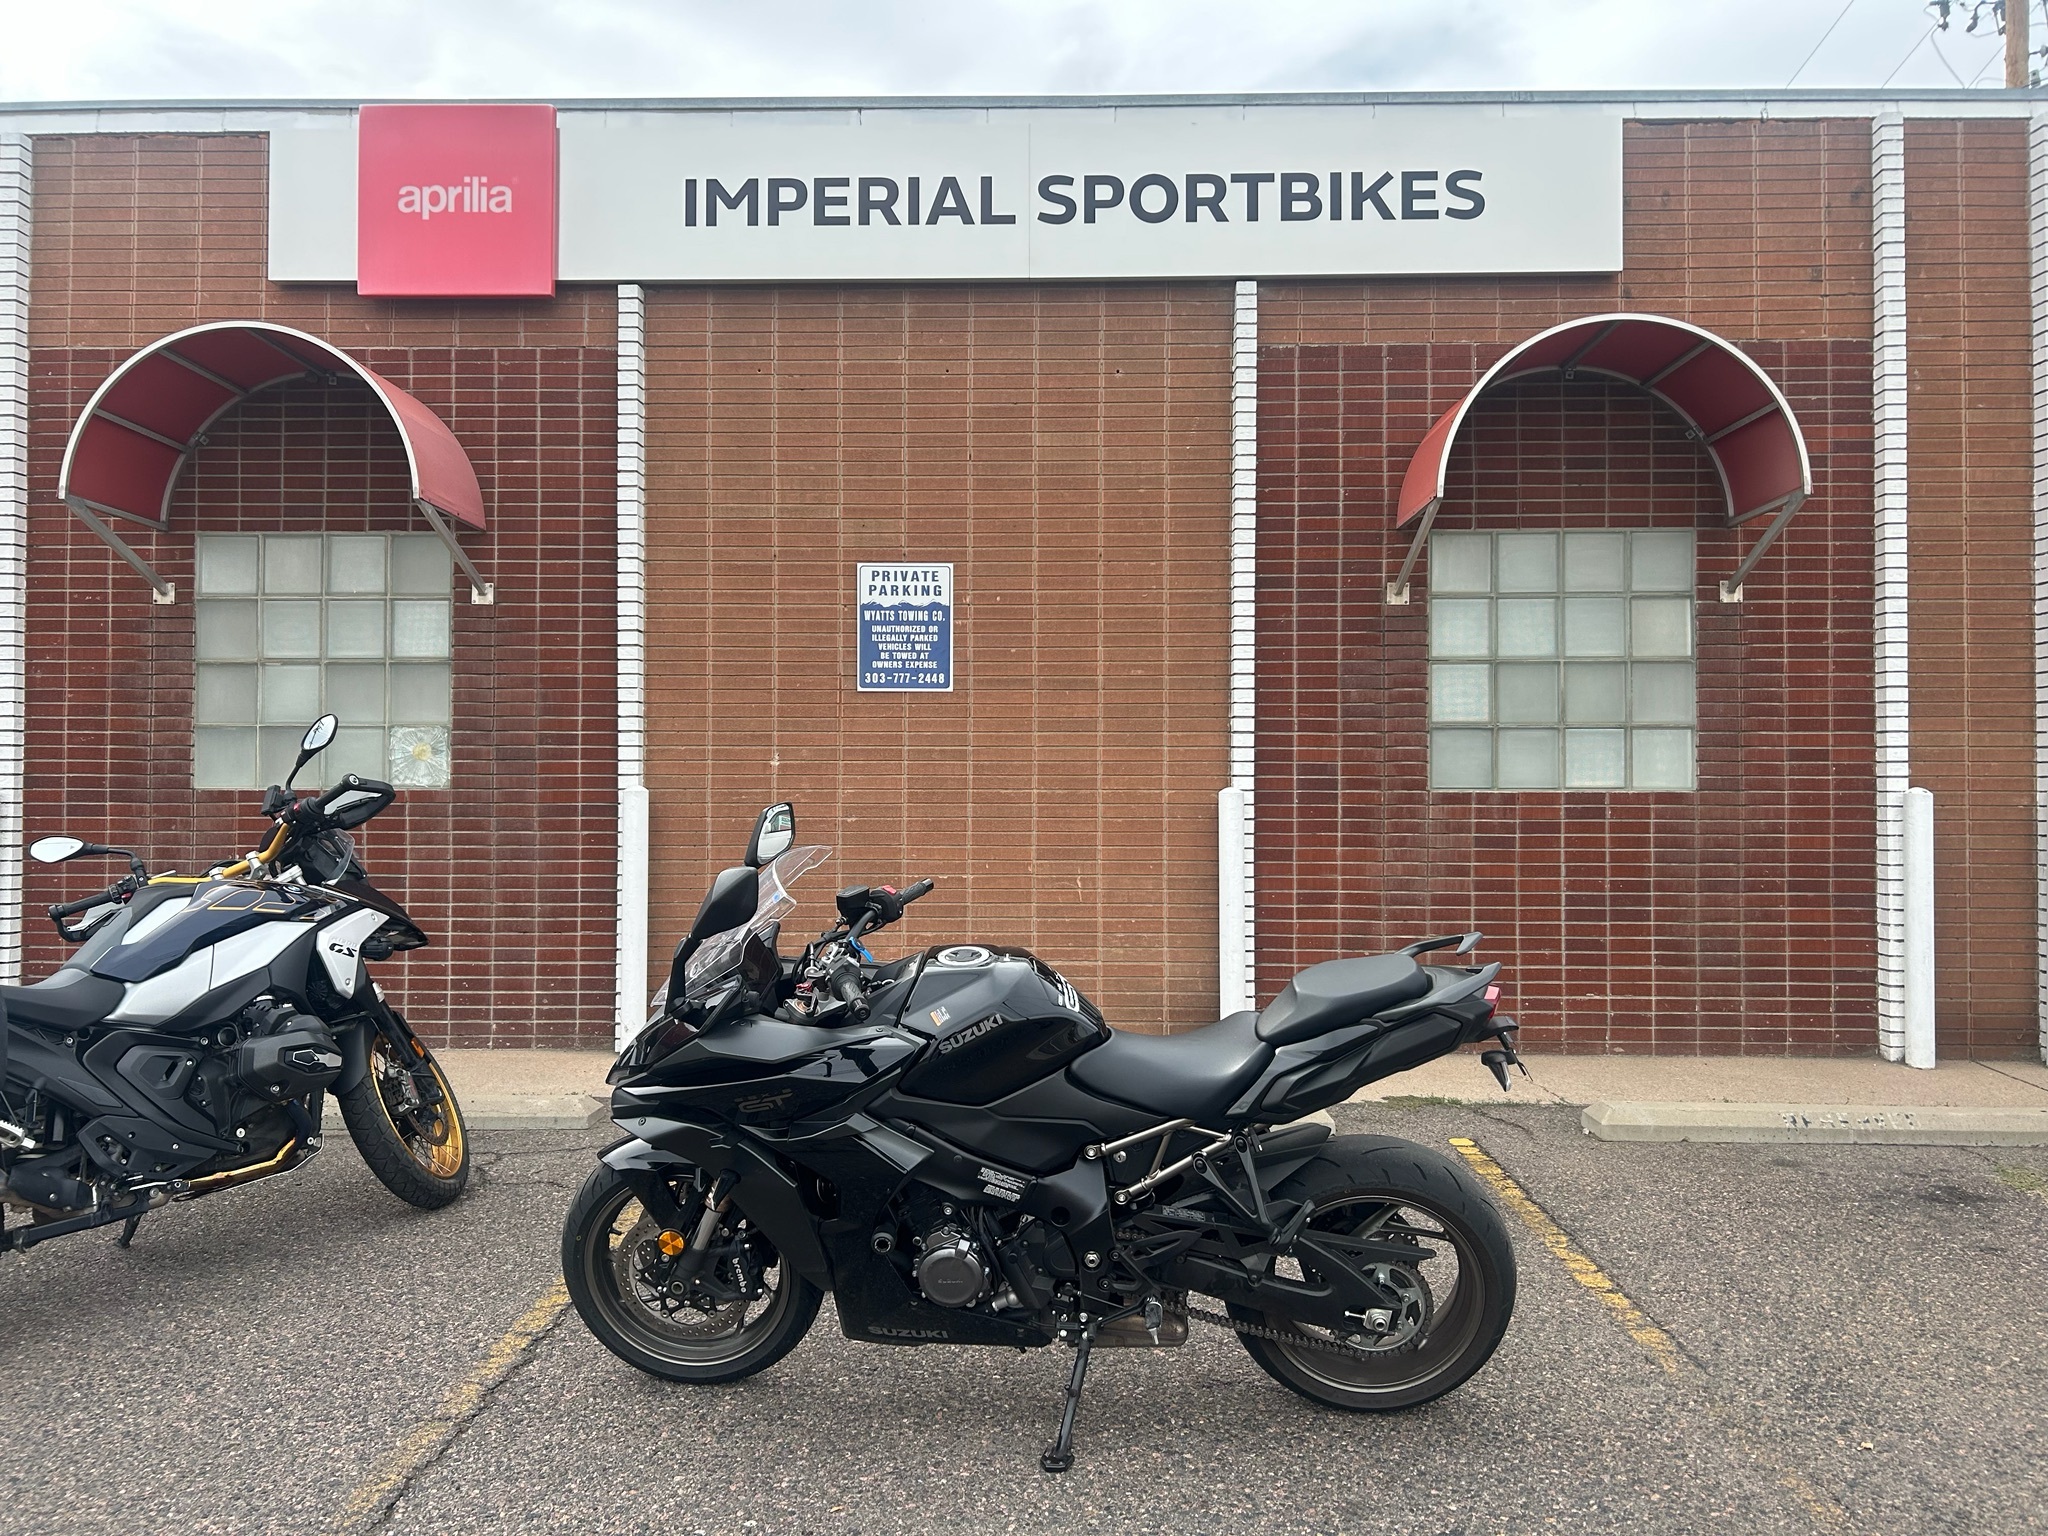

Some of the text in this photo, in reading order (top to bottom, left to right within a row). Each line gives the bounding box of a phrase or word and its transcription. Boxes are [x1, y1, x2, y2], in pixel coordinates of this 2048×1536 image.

[397, 176, 512, 220] aprilia
[684, 170, 1487, 227] IMPERIAL SPORTBIKES
[871, 570, 940, 582] PRIVATE
[868, 585, 942, 596] PARKING
[864, 610, 945, 621] WYATTS TOWING CO.
[871, 625, 939, 633] UNAUTHORIZED OR
[871, 634, 939, 642] ILLEGALLY PARKED
[877, 643, 932, 651] VEHICLES WILL
[880, 652, 930, 660] BE TOWED AT
[871, 661, 938, 669] OWNERS EXPENSE
[864, 672, 945, 684] 303-777-2448
[938, 1013, 1004, 1055] SUZUKI
[732, 1257, 747, 1293] brembo
[867, 1326, 949, 1339] SUZUKI
